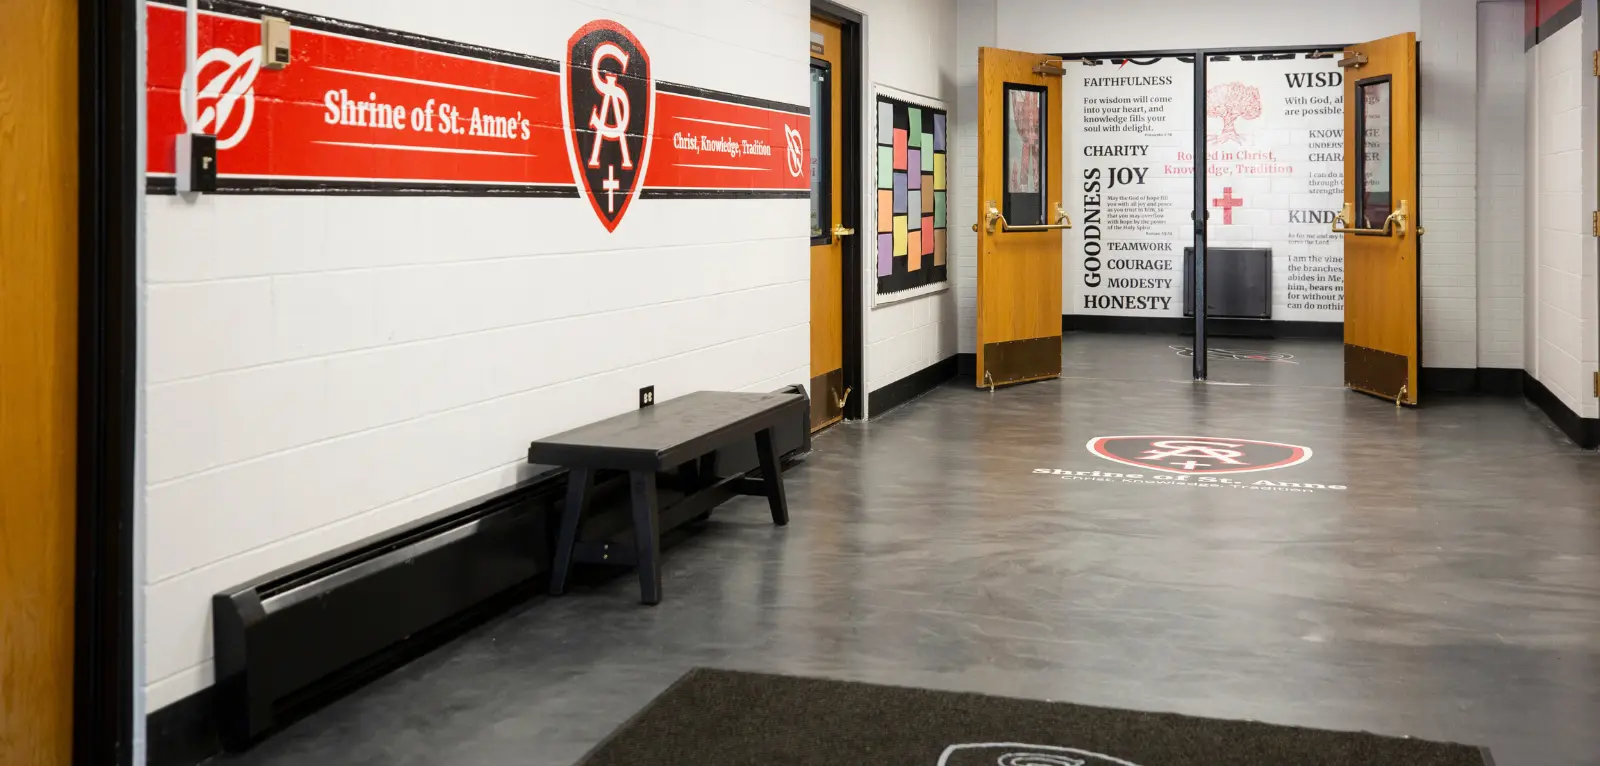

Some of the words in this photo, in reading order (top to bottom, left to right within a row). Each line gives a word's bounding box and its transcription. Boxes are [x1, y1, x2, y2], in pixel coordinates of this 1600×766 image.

[1084, 76, 1172, 87] FAITHFULNESS
[1285, 72, 1343, 88] WISD
[1285, 96, 1307, 104] With
[1310, 96, 1332, 105] God,
[324, 89, 406, 129] Shrine
[411, 98, 434, 132] of
[438, 103, 465, 134] St.
[469, 109, 530, 141] Anne's
[1123, 106, 1147, 114] heart,
[1302, 106, 1344, 116] possible.
[1084, 115, 1127, 124] knowledge
[1123, 124, 1154, 133] delight.
[674, 133, 700, 155] Christ,
[701, 135, 741, 159] Knowledge,
[742, 140, 771, 156] Tradition
[1084, 145, 1148, 156] CHARITY
[1177, 151, 1218, 161] Roed
[1222, 151, 1232, 160] in
[1236, 150, 1277, 162] Christ,
[1236, 164, 1293, 174] Tradition
[1108, 167, 1149, 188] JOY
[1288, 210, 1344, 223] KIND
[1084, 168, 1101, 287] GOODNESS
[1107, 242, 1172, 251] TEAMWORK
[1107, 259, 1172, 270] COURAGE
[1108, 278, 1172, 288] MODESTY
[1328, 275, 1344, 283] Me,
[1084, 295, 1172, 310] HONESTY
[1032, 467, 1144, 478] Shrine
[1154, 473, 1190, 481] of
[1198, 475, 1242, 485] St.
[1249, 479, 1347, 491] Anne
[1122, 478, 1222, 488] Knowledge,
[1229, 484, 1315, 493] Tradition
